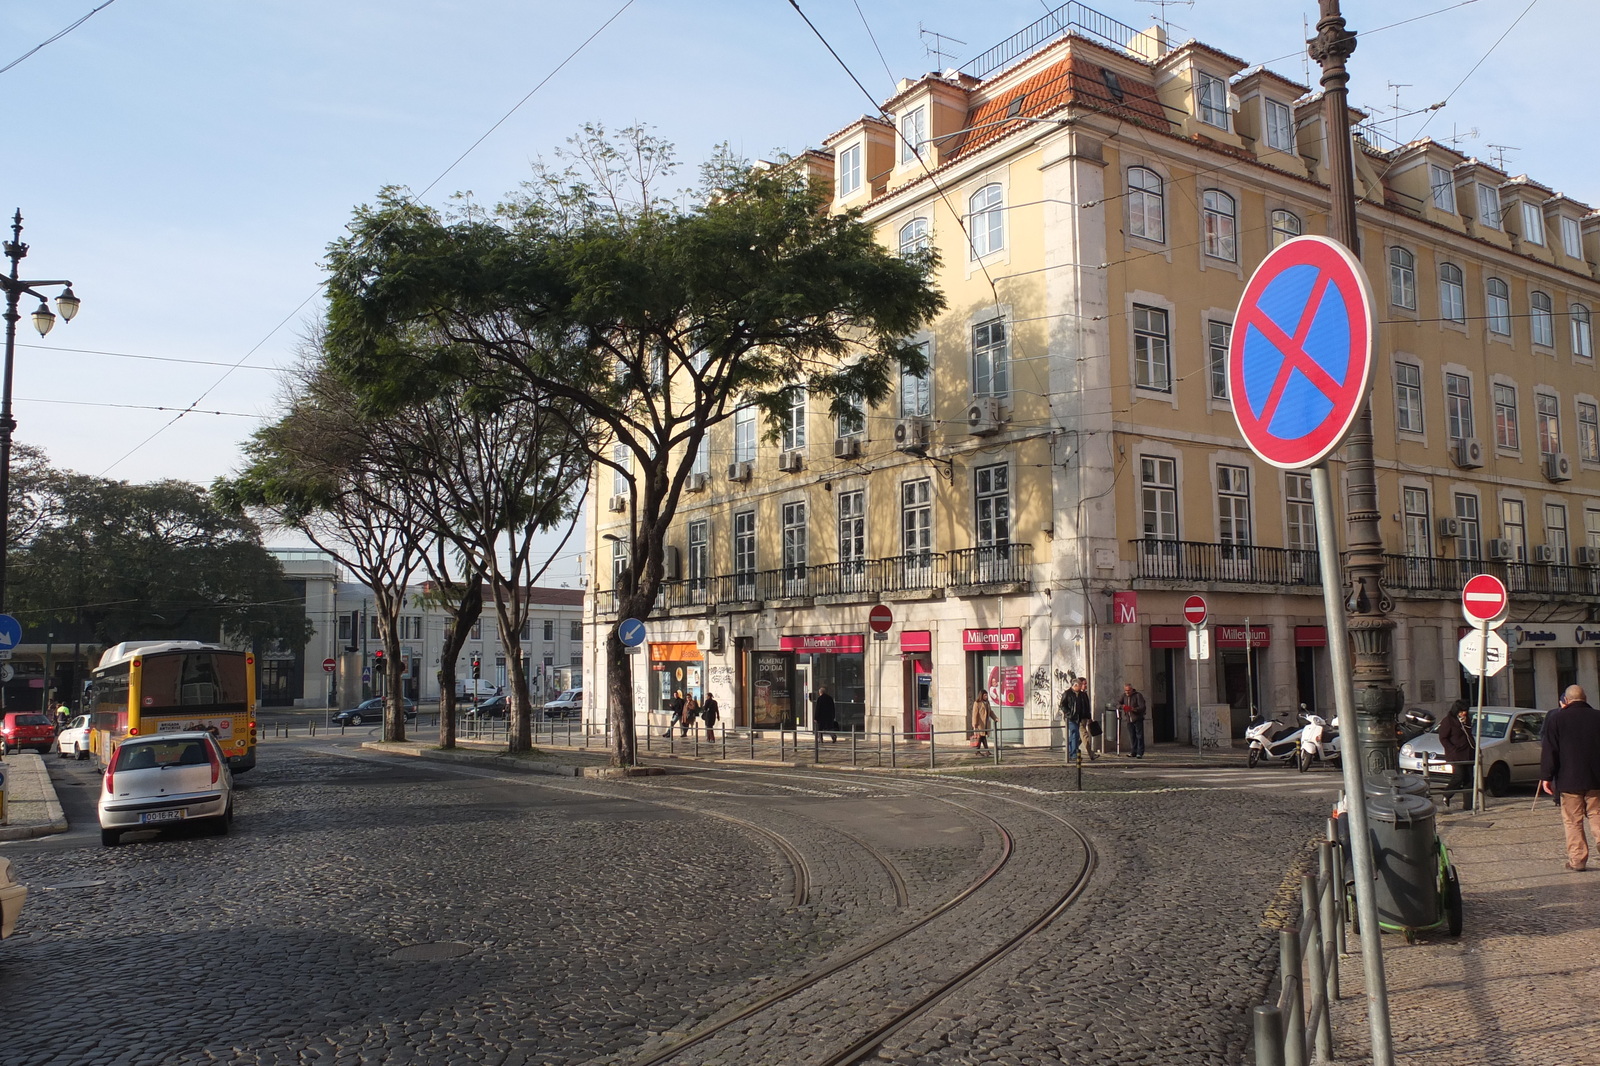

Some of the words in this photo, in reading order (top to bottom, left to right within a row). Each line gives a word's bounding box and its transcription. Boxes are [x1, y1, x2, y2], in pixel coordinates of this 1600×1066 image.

[1120, 603, 1136, 623] M
[803, 636, 836, 647] Millennium
[967, 630, 1015, 643] Millennum
